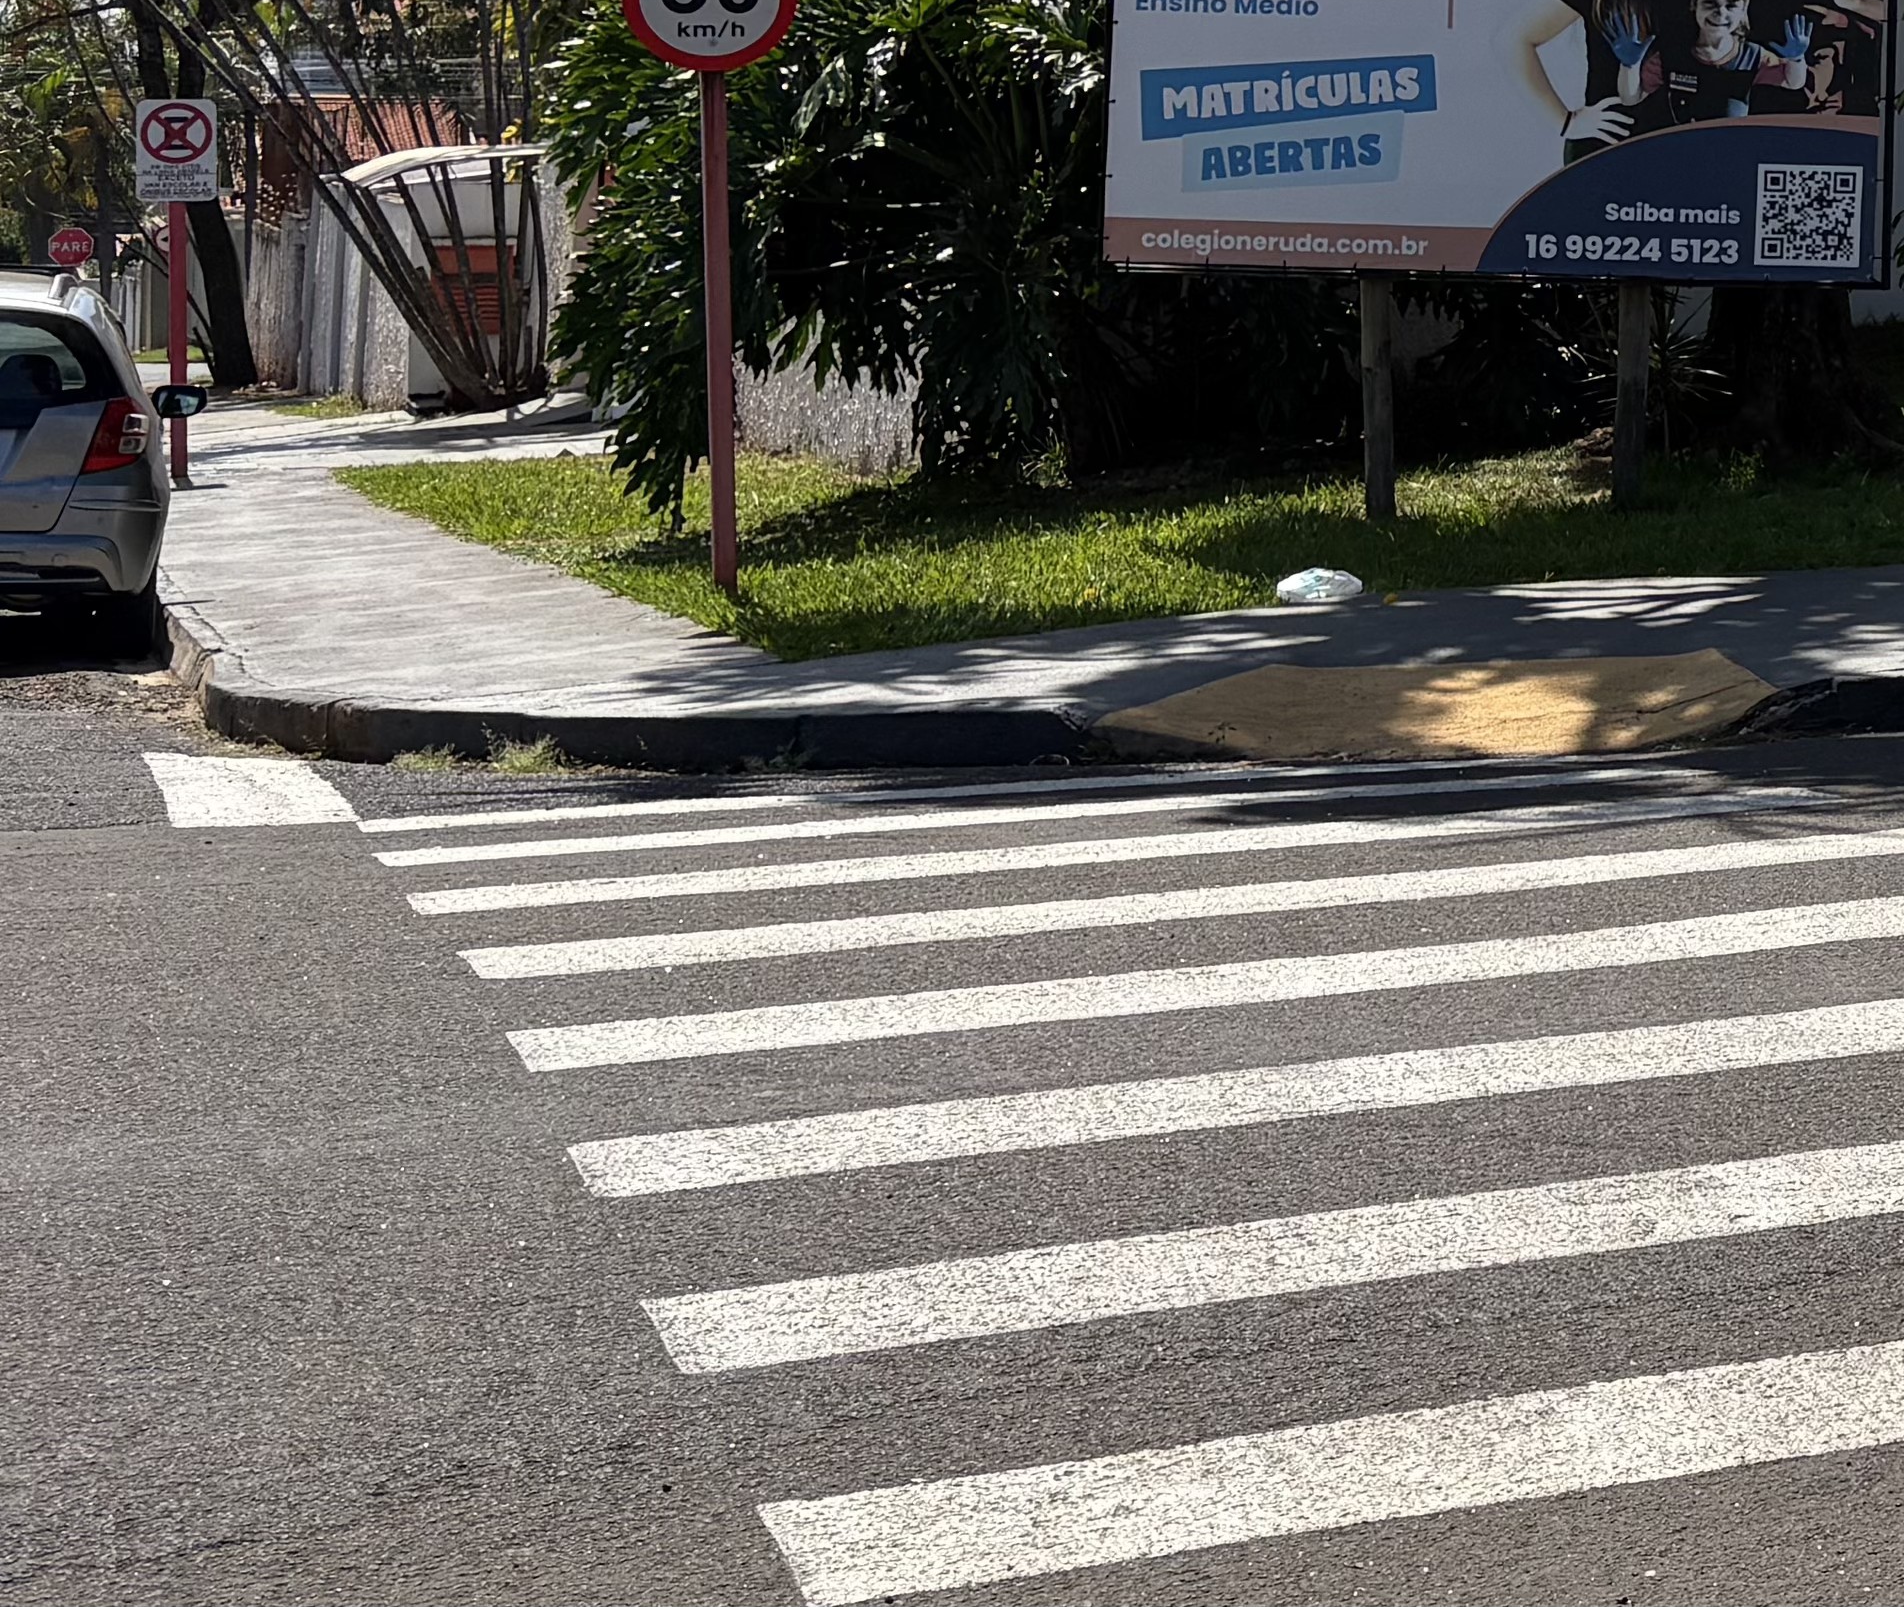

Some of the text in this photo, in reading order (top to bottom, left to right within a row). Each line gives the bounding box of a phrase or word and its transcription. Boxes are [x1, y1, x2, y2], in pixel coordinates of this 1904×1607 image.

[677, 19, 745, 38] km/h
[1162, 67, 1421, 120] MATRÍCULAS
[1201, 133, 1382, 181] ABERTAS
[1605, 202, 1741, 224] Saiba mais
[51, 241, 90, 253] PARE
[1141, 229, 1429, 256] colegioneruda.com.br
[1525, 234, 1739, 265] 16 99224 5123
